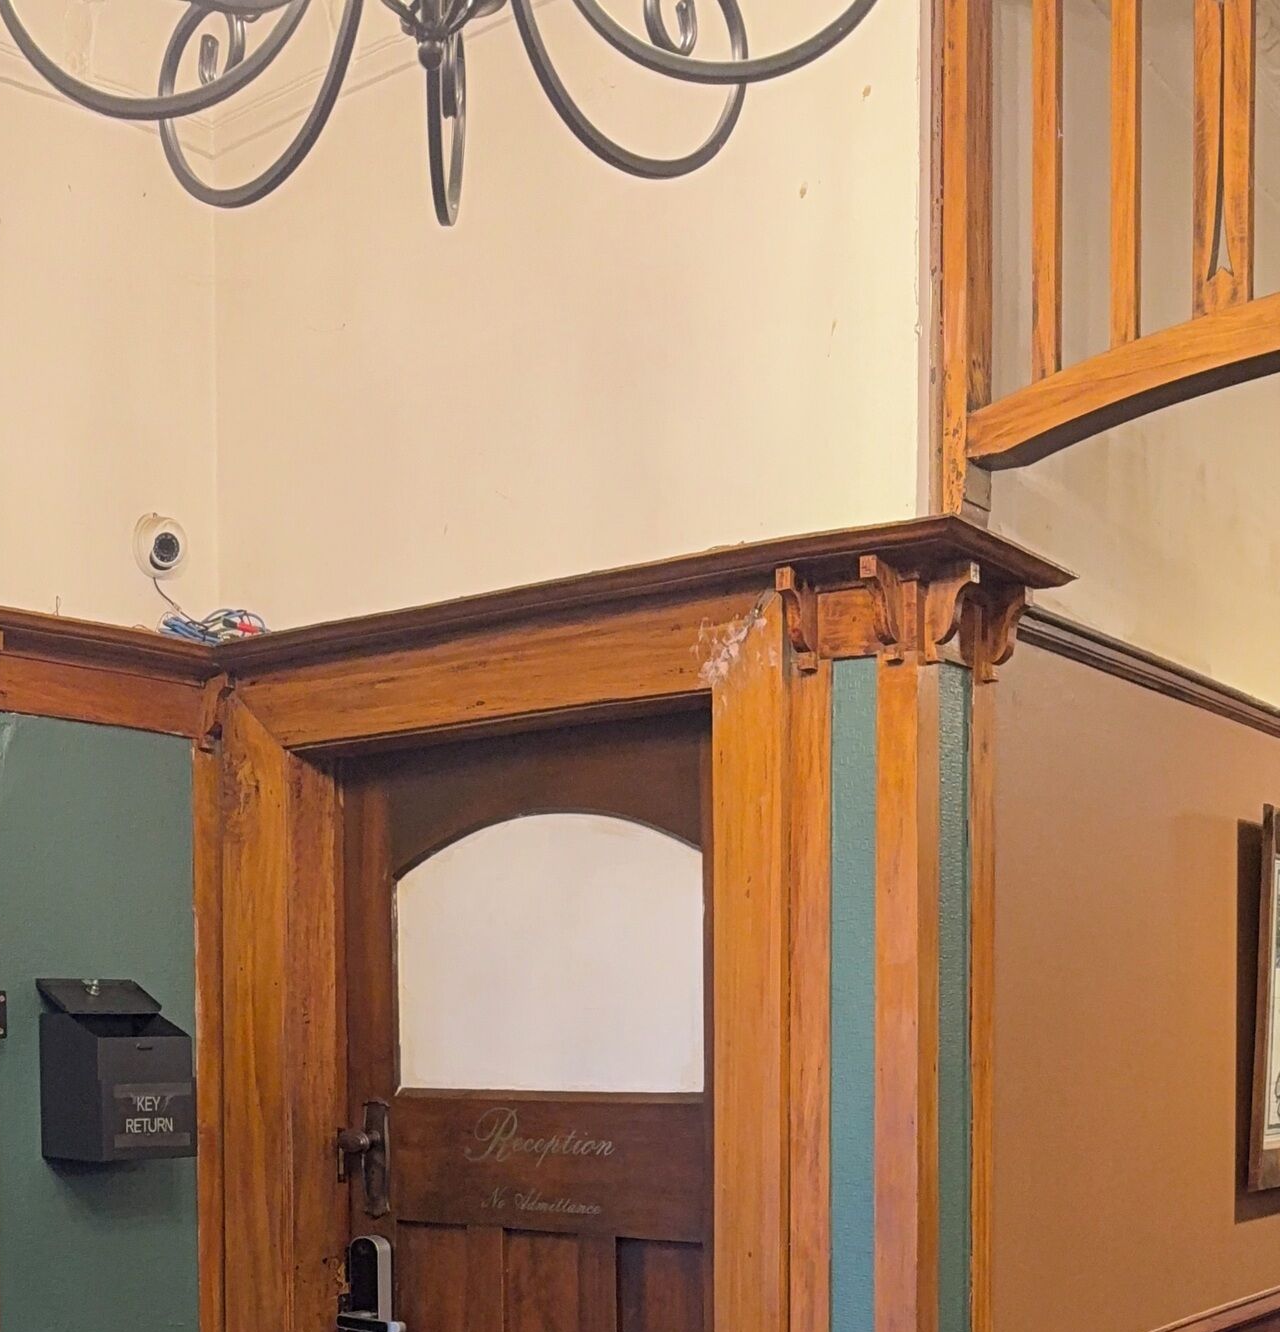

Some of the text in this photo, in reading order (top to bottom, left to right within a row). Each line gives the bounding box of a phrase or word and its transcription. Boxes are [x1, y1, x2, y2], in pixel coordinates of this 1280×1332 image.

[136, 1096, 160, 1112] KEY
[125, 1118, 173, 1133] RETURN
[463, 1107, 615, 1168] Reception
[481, 1187, 602, 1215] No Admittance
